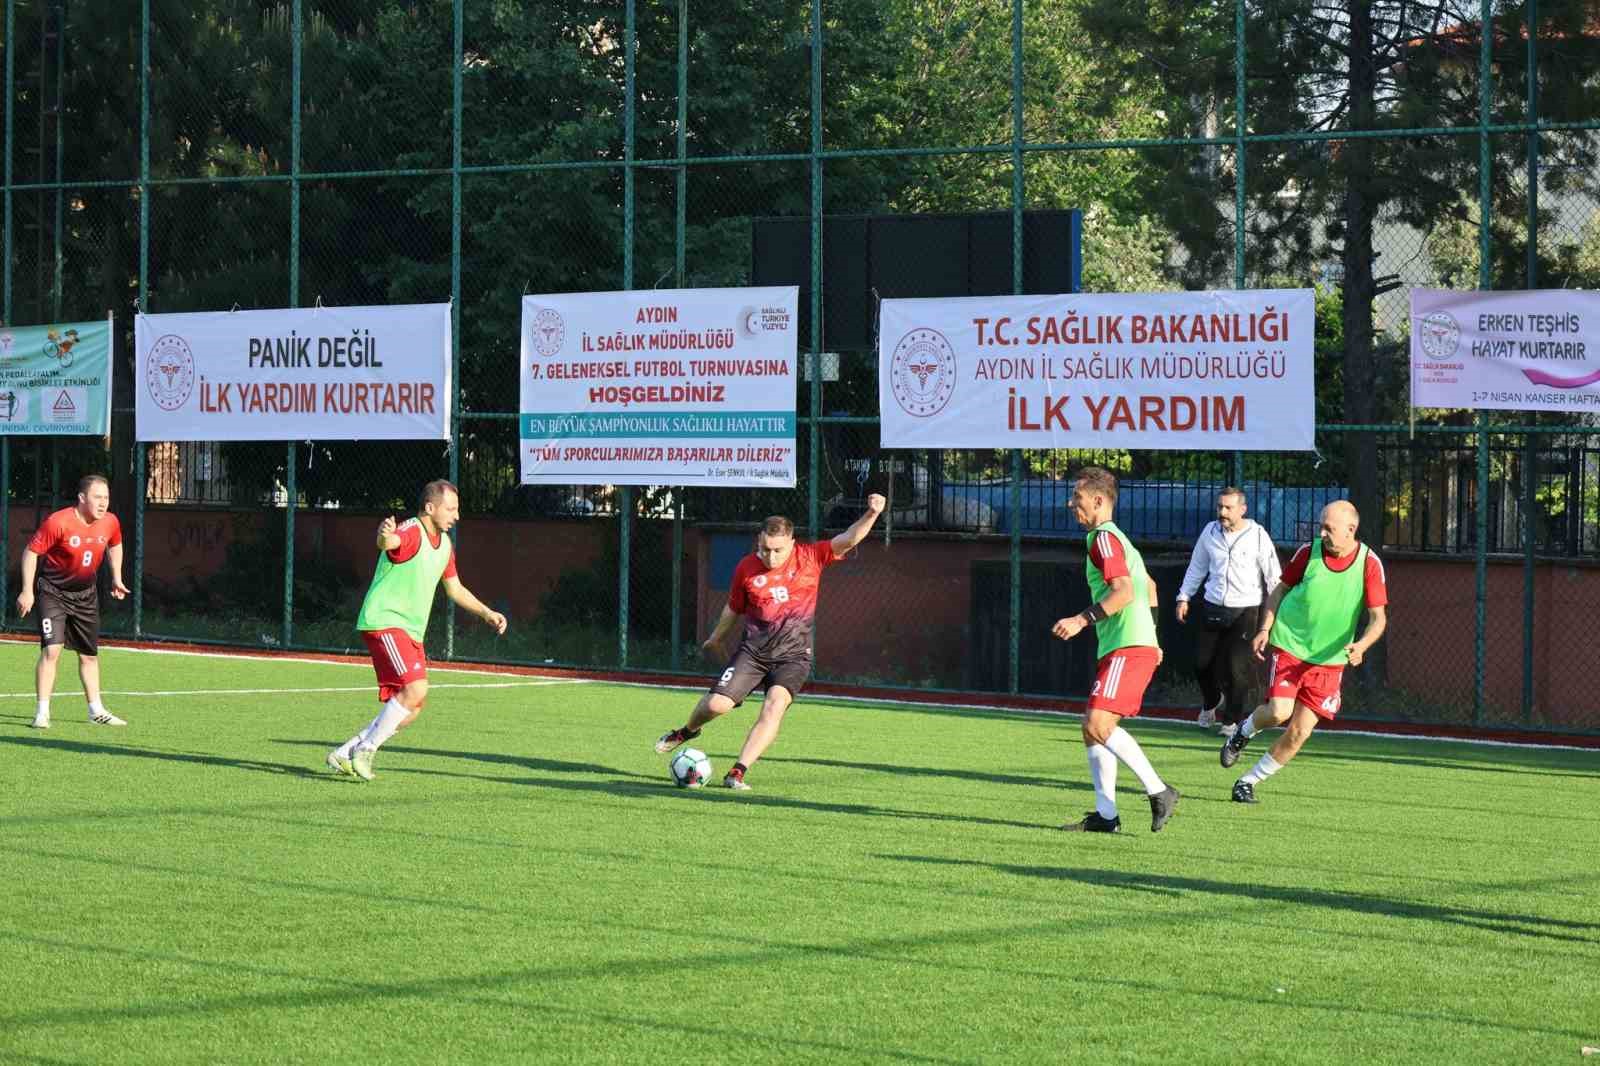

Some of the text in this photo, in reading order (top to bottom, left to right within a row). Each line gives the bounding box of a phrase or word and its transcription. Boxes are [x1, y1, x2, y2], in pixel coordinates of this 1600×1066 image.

[636, 307, 677, 325] AYDIN
[973, 306, 1289, 346] T.C. SAĞLIK BAKANLIĞI
[1478, 312, 1580, 337] ERKEN TEŞHİS
[249, 328, 382, 368] PANİK DEĞİL
[582, 328, 734, 353] İL SAĞLIK MÜDÜRLÜĞÜ
[1472, 341, 1586, 361] HAYAT KURTARIR
[532, 359, 789, 380] 7. GELENEKSEL FUTBOL TURNUVASINA
[975, 358, 1034, 381] AYDIN
[1041, 353, 1057, 380] İL
[1064, 352, 1132, 380] SAĞLIK
[1141, 350, 1287, 380] MÜDÜRLÜĞÜ
[200, 375, 436, 414] İLK YARDIM KURTARIR
[589, 381, 725, 407] HOŞGELDİNİZ
[1525, 392, 1566, 404] KANSER
[1008, 388, 1246, 432] İLK YARDIM
[530, 414, 786, 435] EN BÜYÜK ŞAMPİYONLUK SAĞLIKLI HAYATTIR
[564, 447, 664, 462] SPORCULARIMIZA
[667, 447, 733, 465] BAŞARILAR
[82, 551, 93, 567] 8
[42, 618, 52, 634] 8
